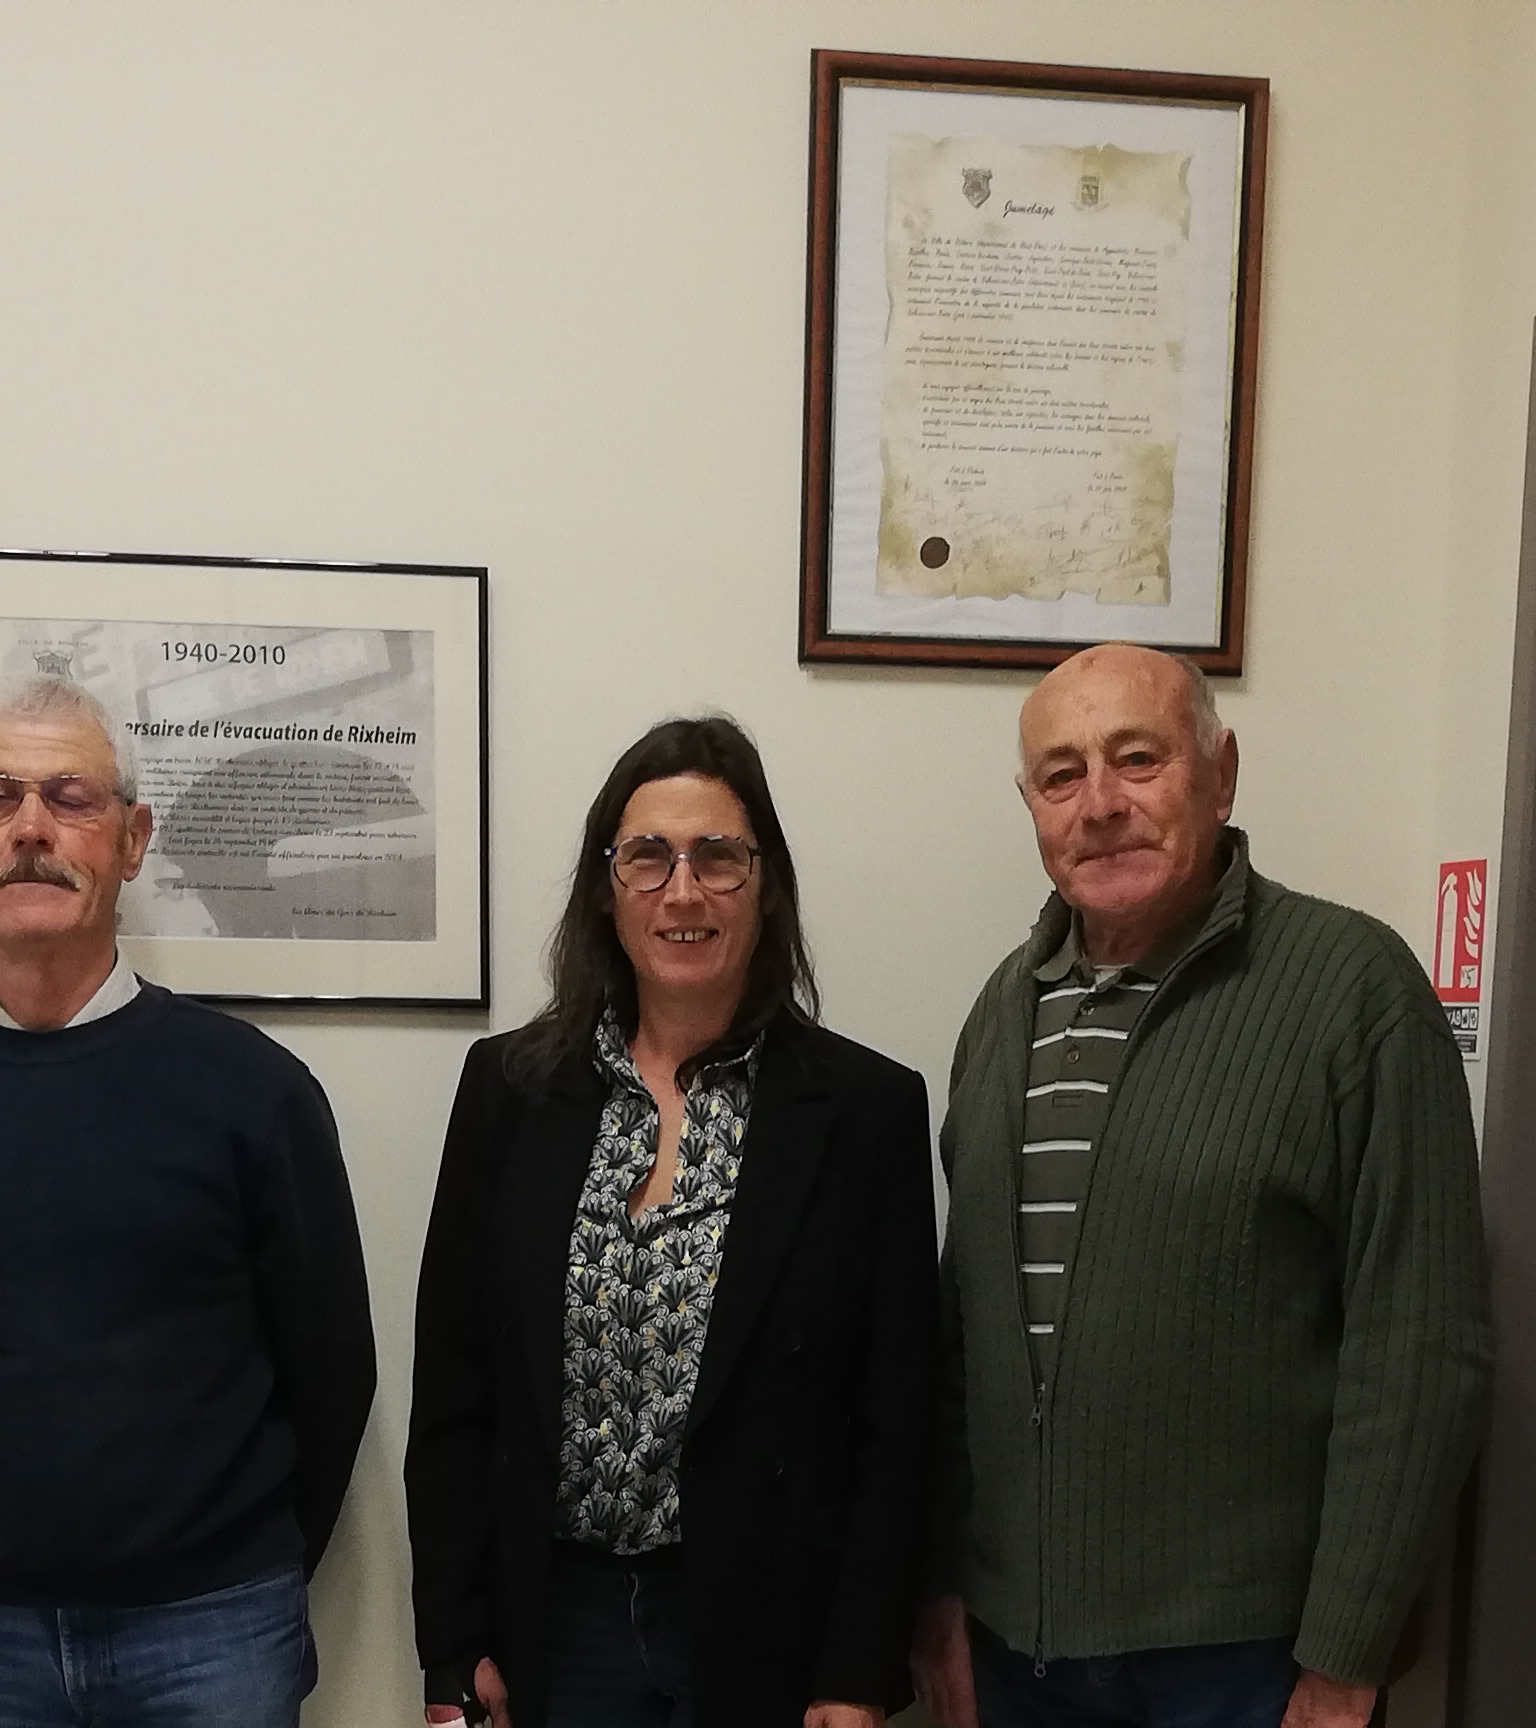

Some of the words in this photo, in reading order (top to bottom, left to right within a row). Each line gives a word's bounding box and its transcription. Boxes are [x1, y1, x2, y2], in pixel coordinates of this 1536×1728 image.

[160, 641, 287, 666] 1940-2010
[188, 719, 210, 738] de
[213, 720, 319, 742] l'évacuation
[322, 723, 344, 743] de
[347, 725, 417, 746] Rixheim
